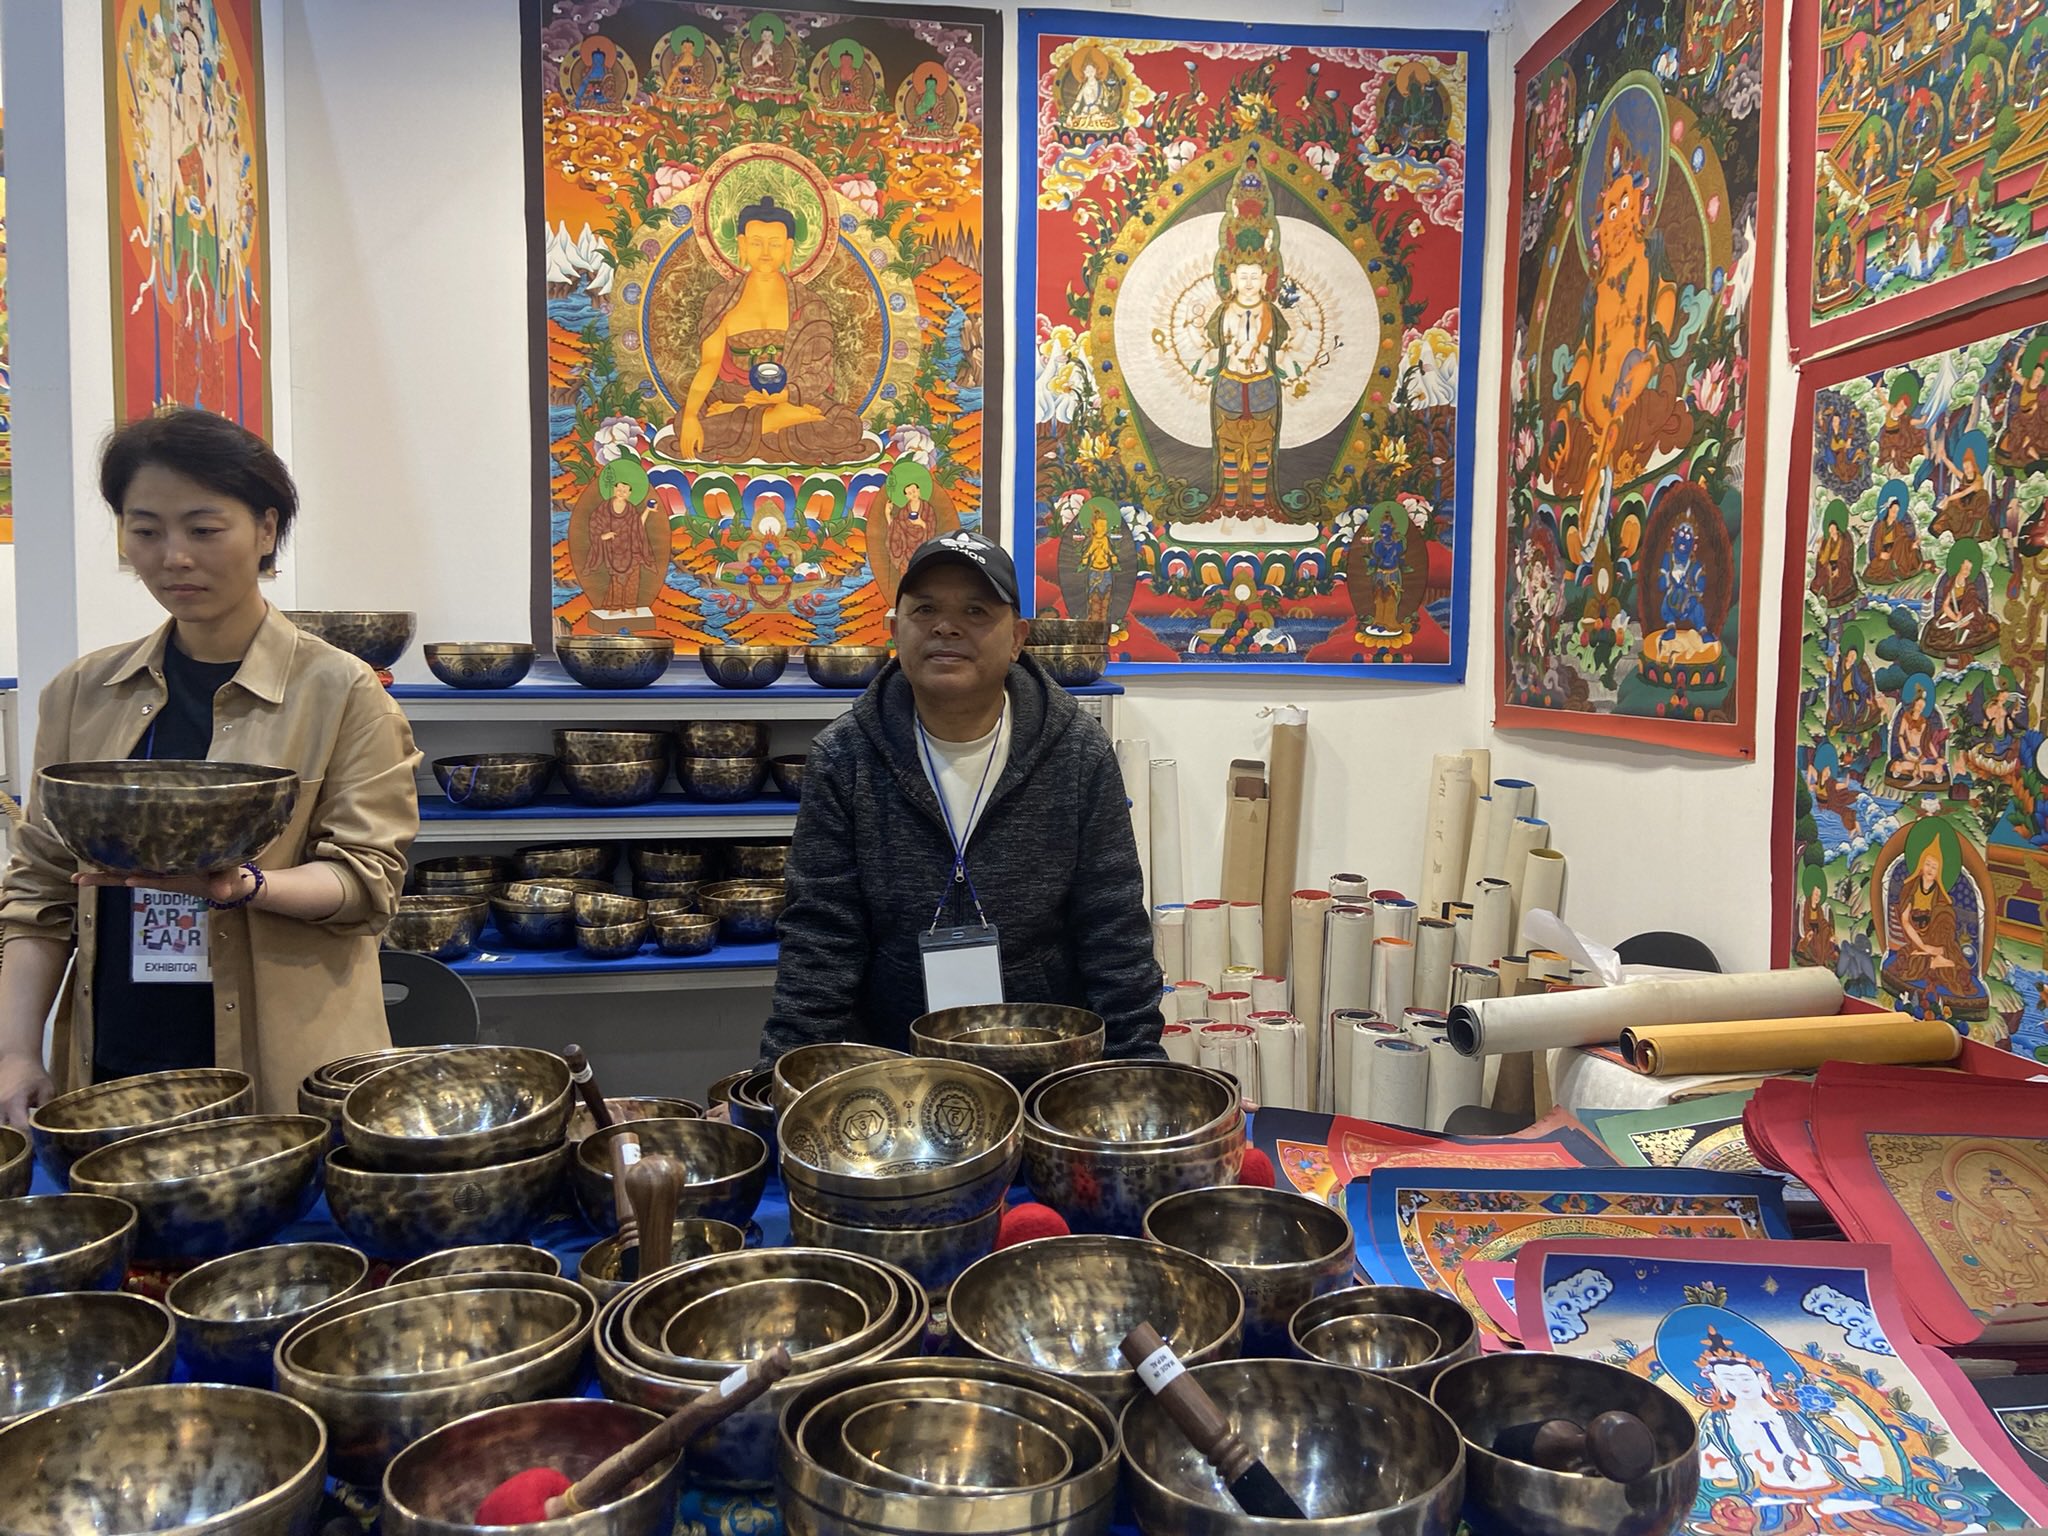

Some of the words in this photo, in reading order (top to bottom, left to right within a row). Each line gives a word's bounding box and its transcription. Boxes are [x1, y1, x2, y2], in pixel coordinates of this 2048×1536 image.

[144, 908, 199, 927] ART
[143, 929, 201, 946] FAIR
[144, 962, 198, 973] EXHIBITOR
[1149, 1353, 1168, 1369] NEPAL
[1159, 1359, 1176, 1374] MADE
[1153, 1370, 1162, 1379] IN
